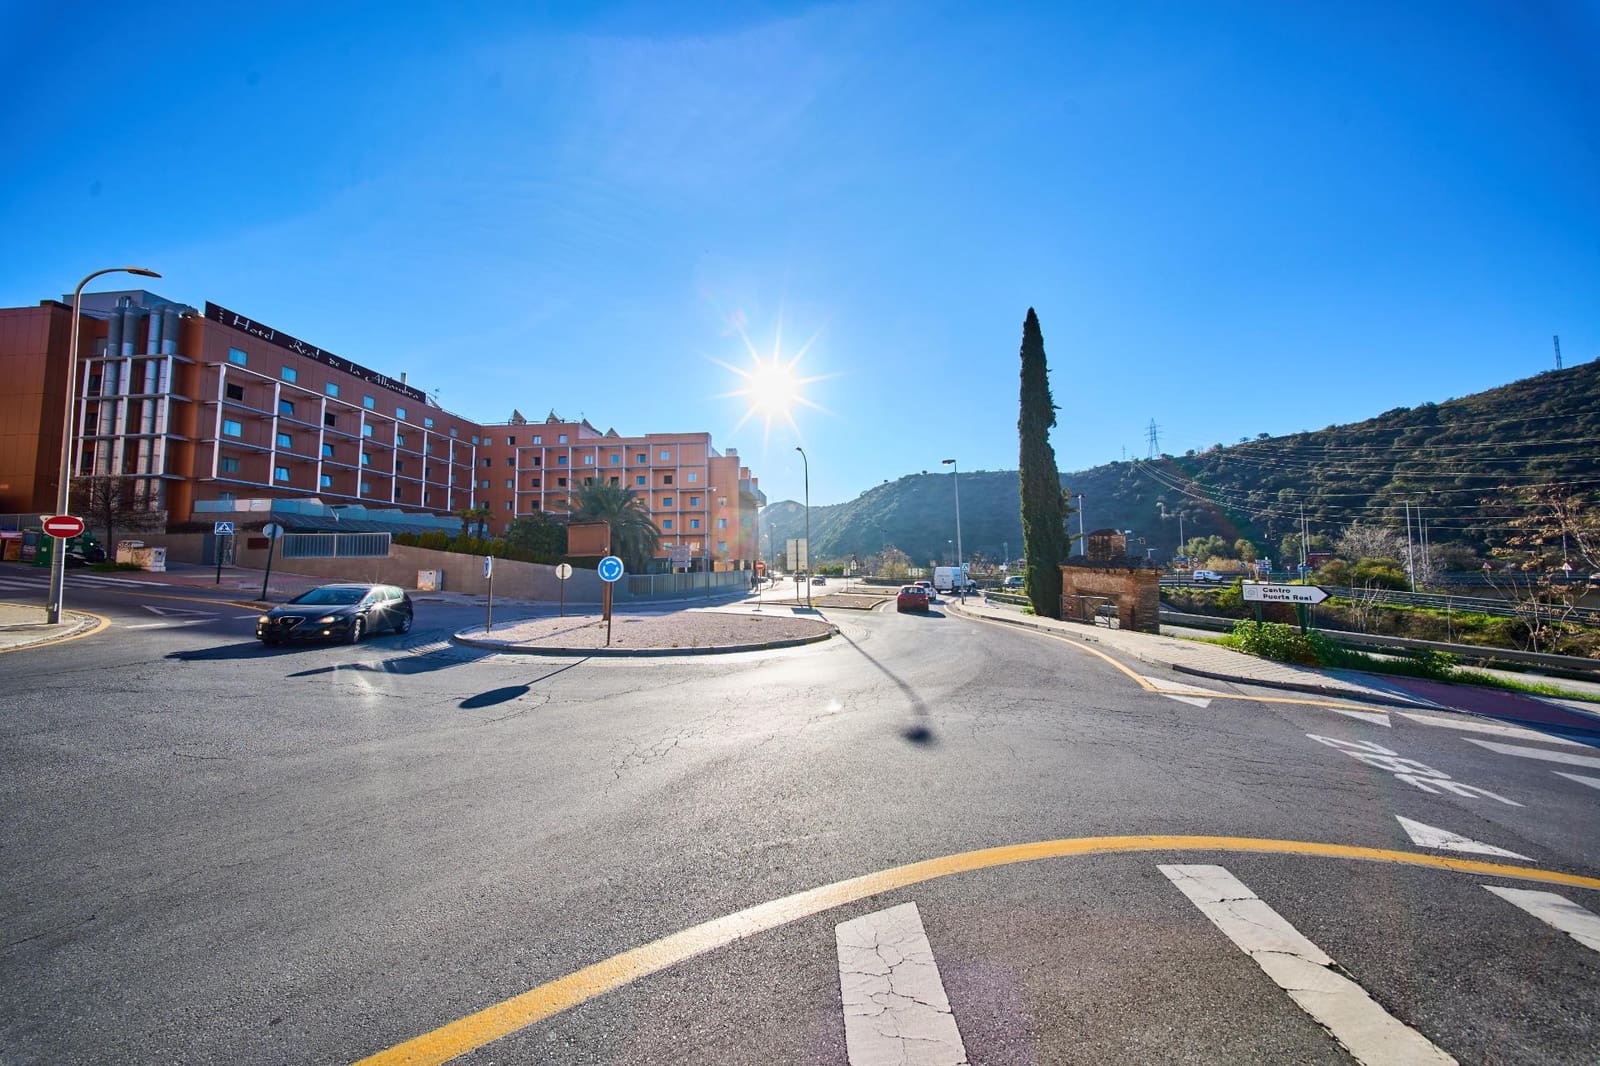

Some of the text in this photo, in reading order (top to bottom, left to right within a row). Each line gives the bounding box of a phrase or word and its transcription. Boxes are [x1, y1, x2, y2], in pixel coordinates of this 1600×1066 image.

[232, 314, 420, 400] Hotel Real de la Alhambra
